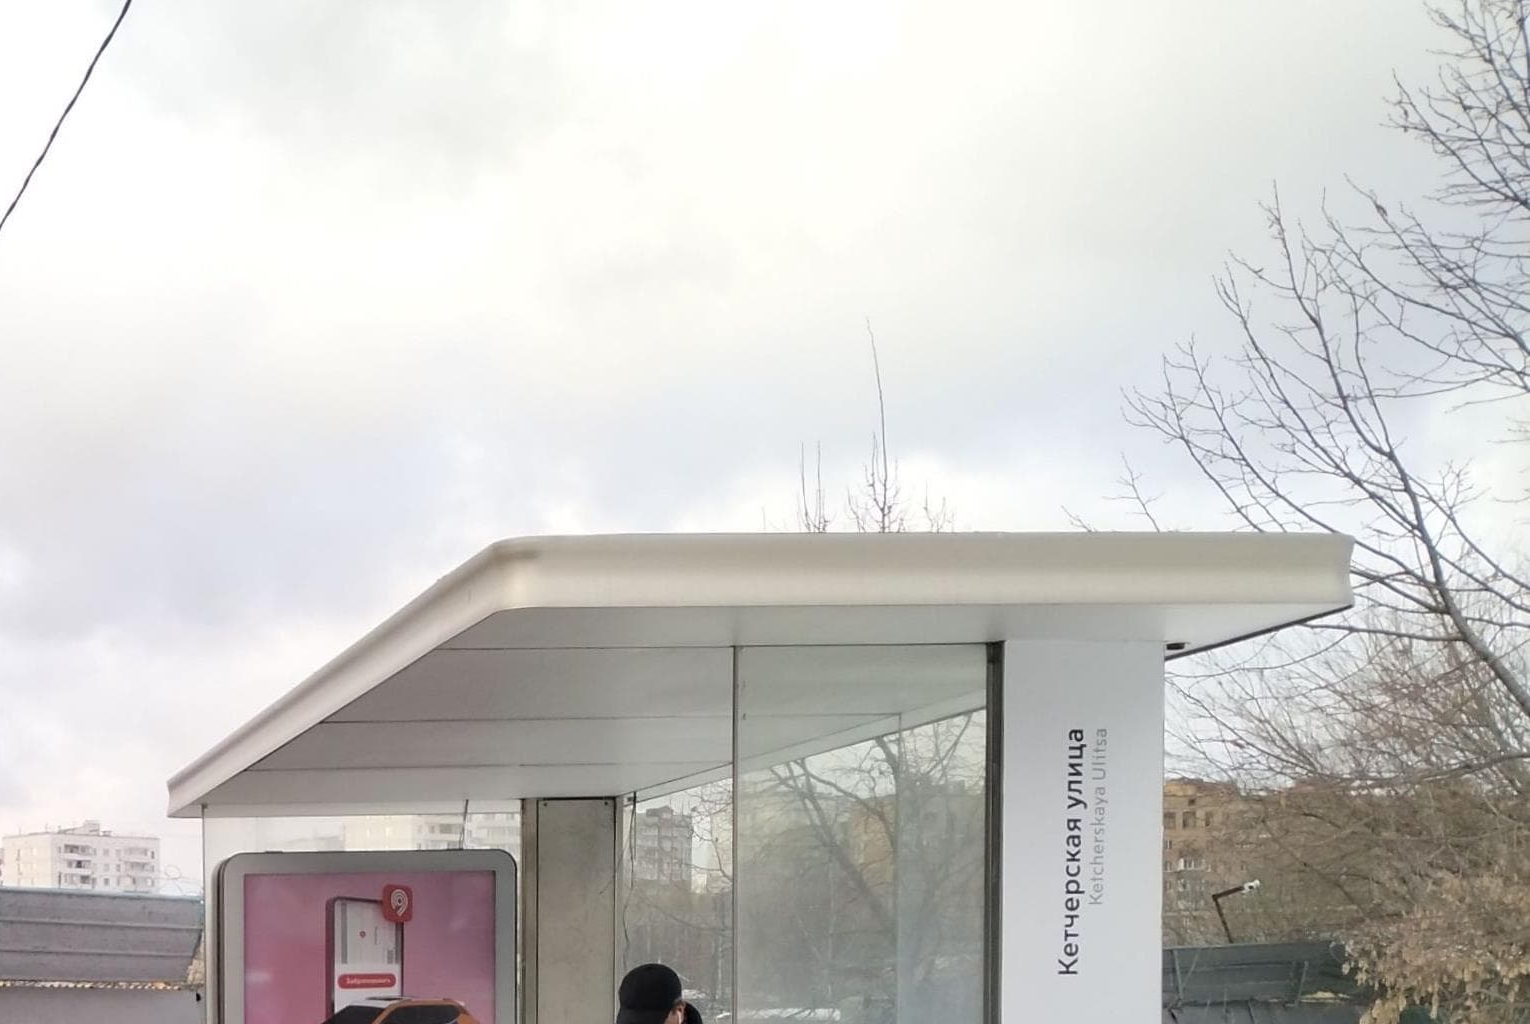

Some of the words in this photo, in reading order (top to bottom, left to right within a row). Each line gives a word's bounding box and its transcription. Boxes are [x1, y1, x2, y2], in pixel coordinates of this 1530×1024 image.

[1067, 728, 1087, 809] улица
[1091, 728, 1107, 780] Ulitsa
[1088, 786, 1108, 905] Ketcherskaya
[1057, 819, 1085, 975] Кетчерская
